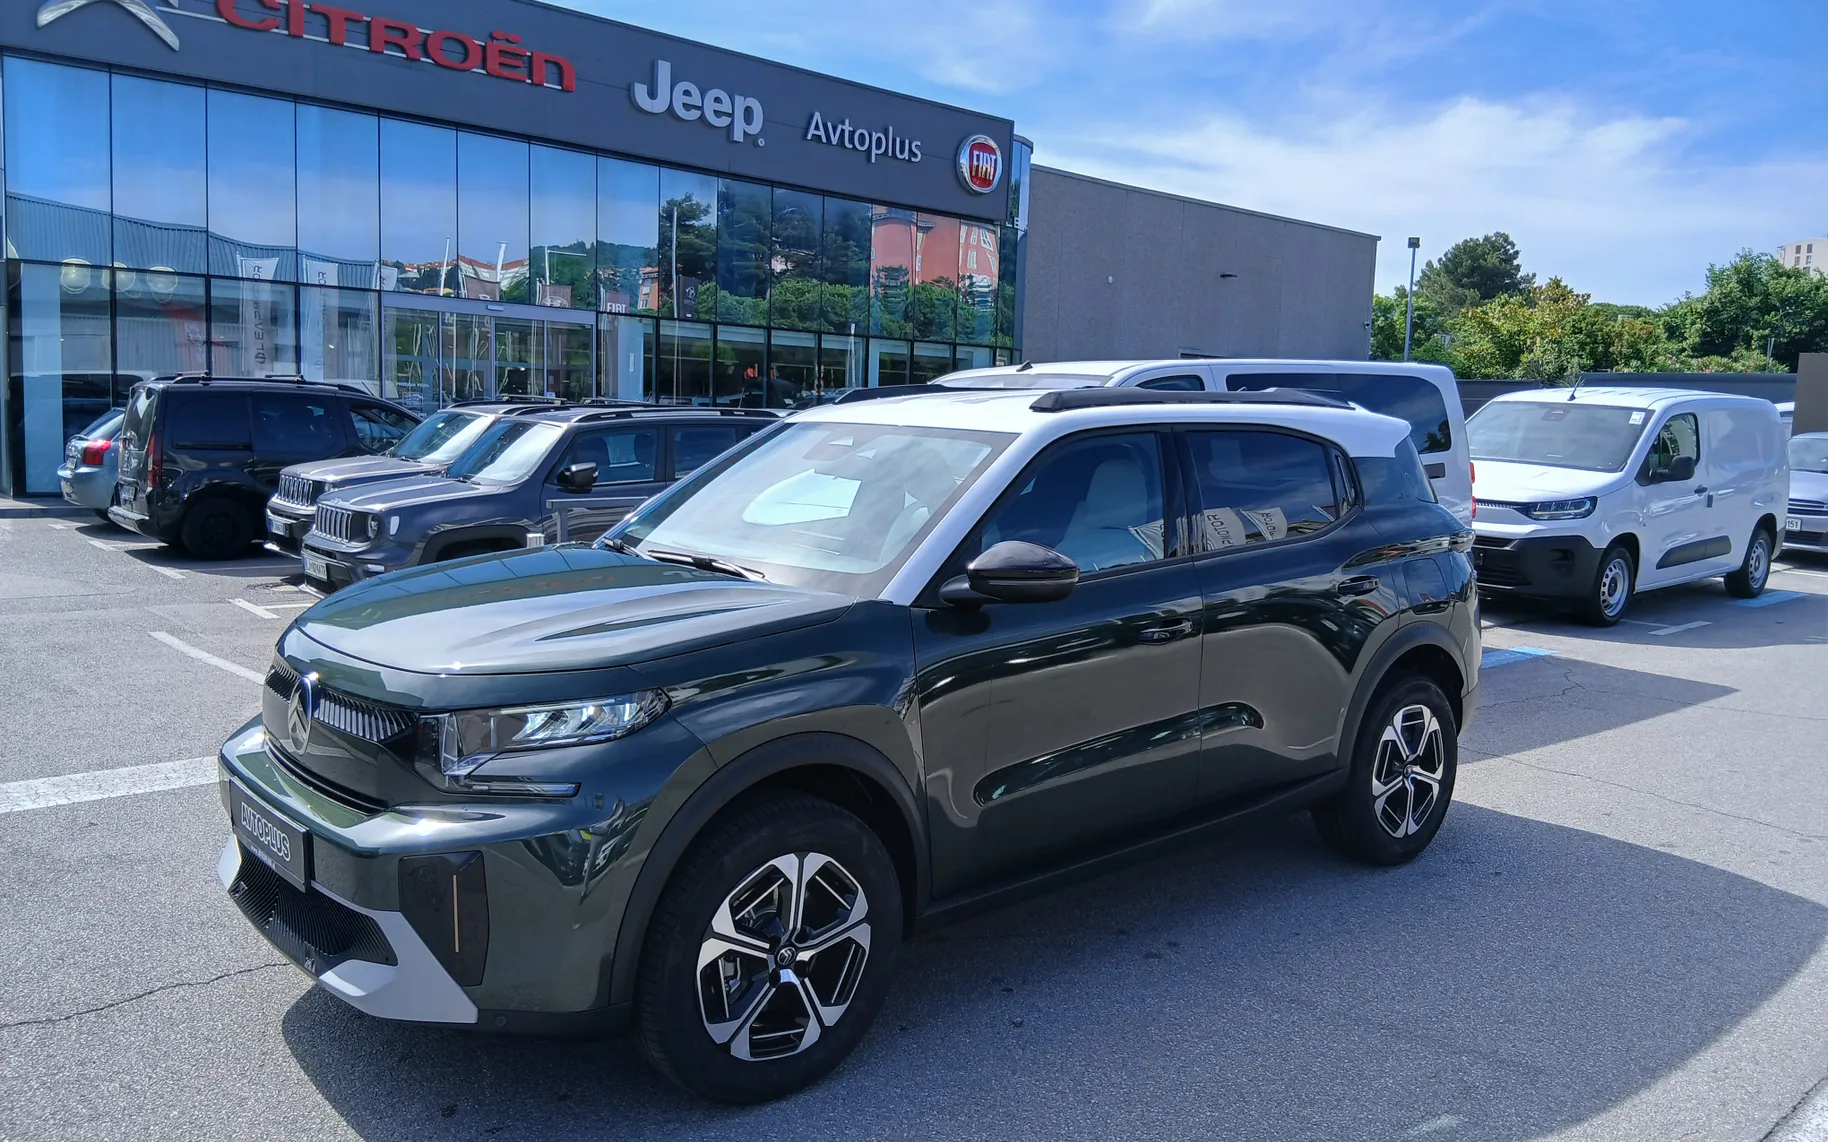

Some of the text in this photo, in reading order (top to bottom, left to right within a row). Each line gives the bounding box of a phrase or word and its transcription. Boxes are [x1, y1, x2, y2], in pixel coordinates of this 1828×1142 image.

[631, 59, 764, 143] Jeep
[806, 111, 922, 164] Avtoplus
[972, 150, 997, 180] FIAT
[607, 302, 627, 314] FIAT
[241, 801, 291, 862] AVTOPLUS
